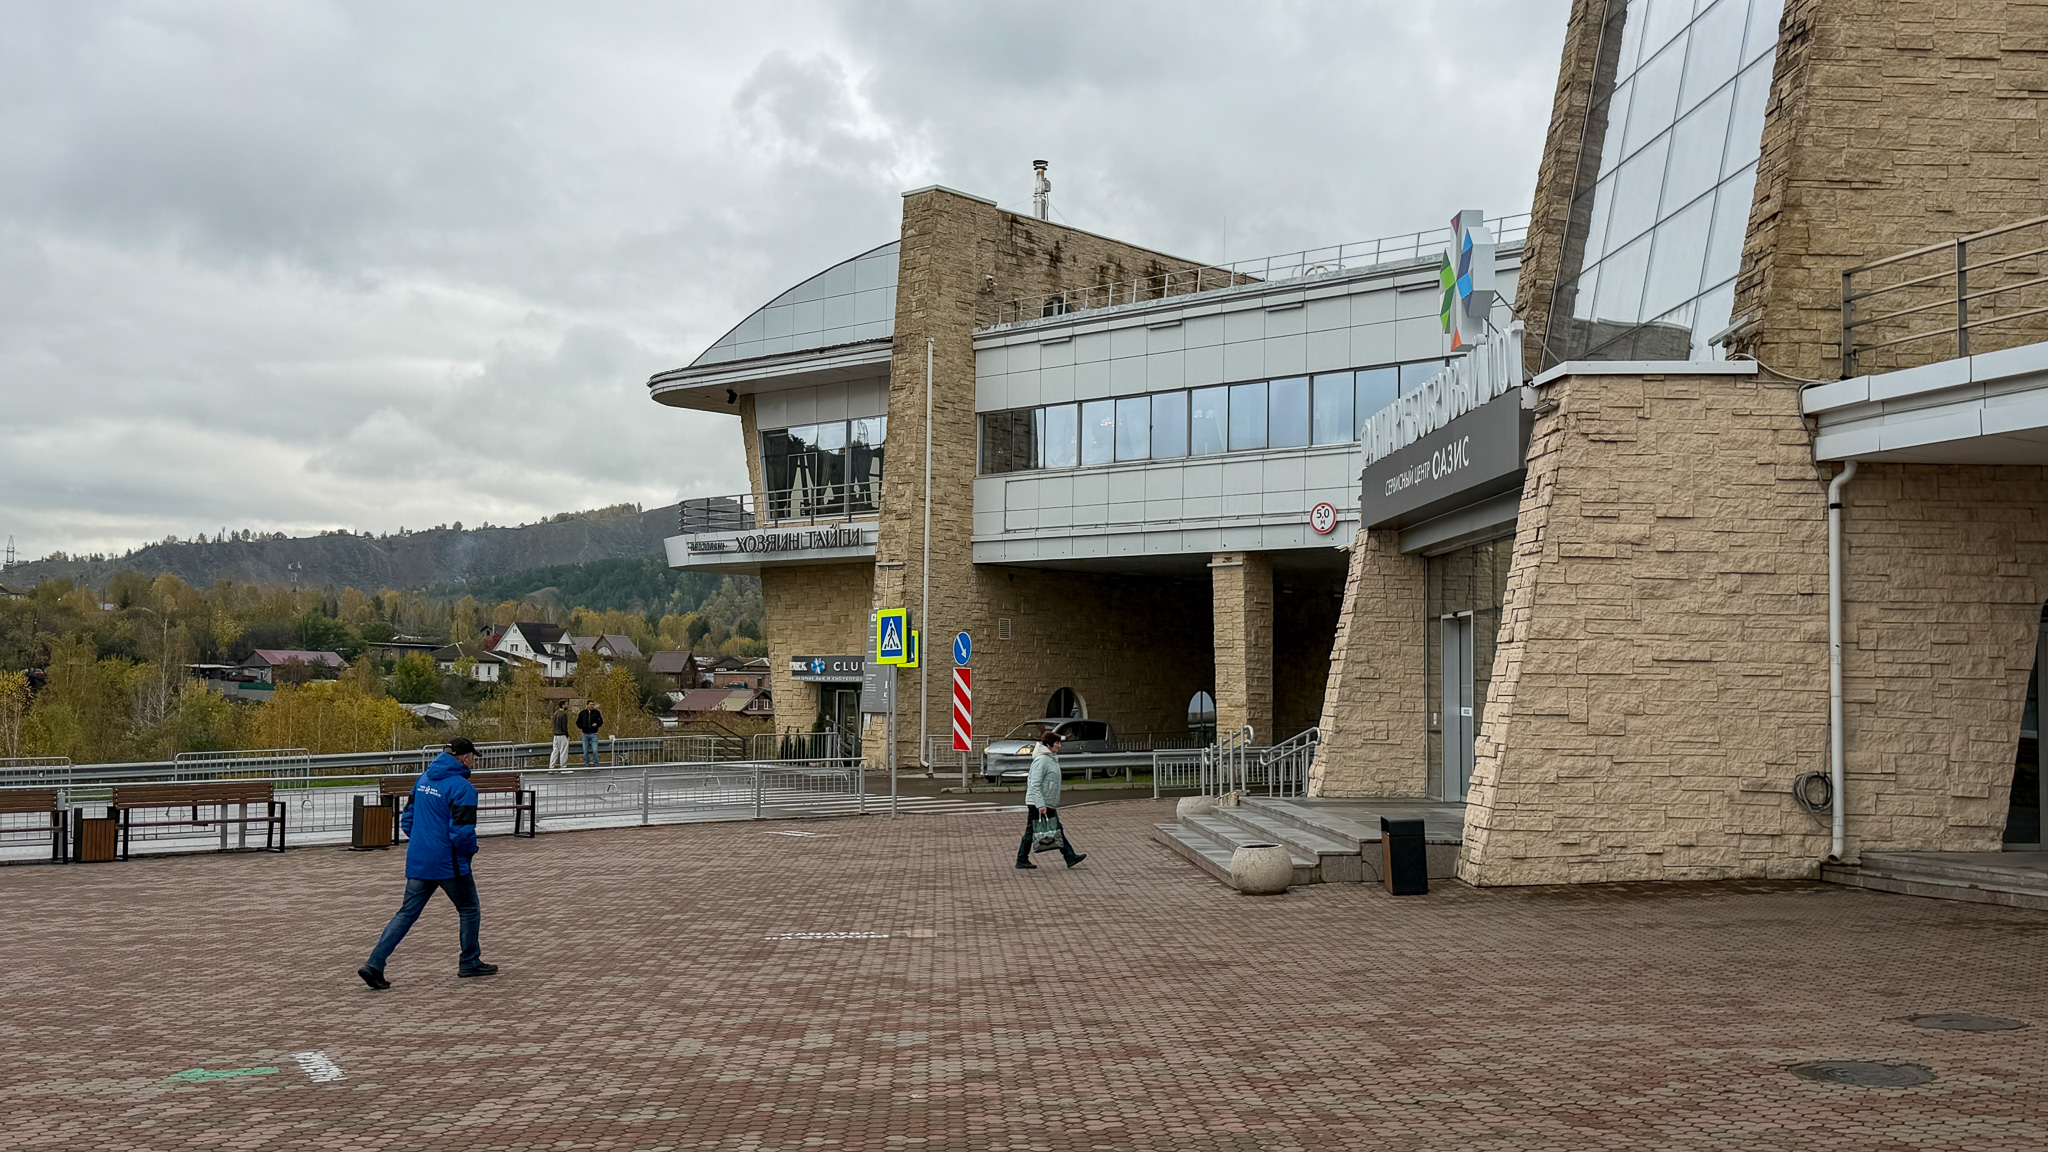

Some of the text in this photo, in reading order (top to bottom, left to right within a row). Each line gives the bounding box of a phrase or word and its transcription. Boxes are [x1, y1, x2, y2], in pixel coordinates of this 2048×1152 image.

[1404, 334, 1488, 446] БОБРОВЫЙ
[1480, 320, 1524, 404] ЛОГ
[1385, 435, 1470, 496] СЕРВИСНЫЙ ЦЕНТР ОАЗИС
[1316, 508, 1330, 519] 5,0
[735, 532, 803, 554] ХОЗЯИН
[804, 523, 864, 550] ТАЙГИ
